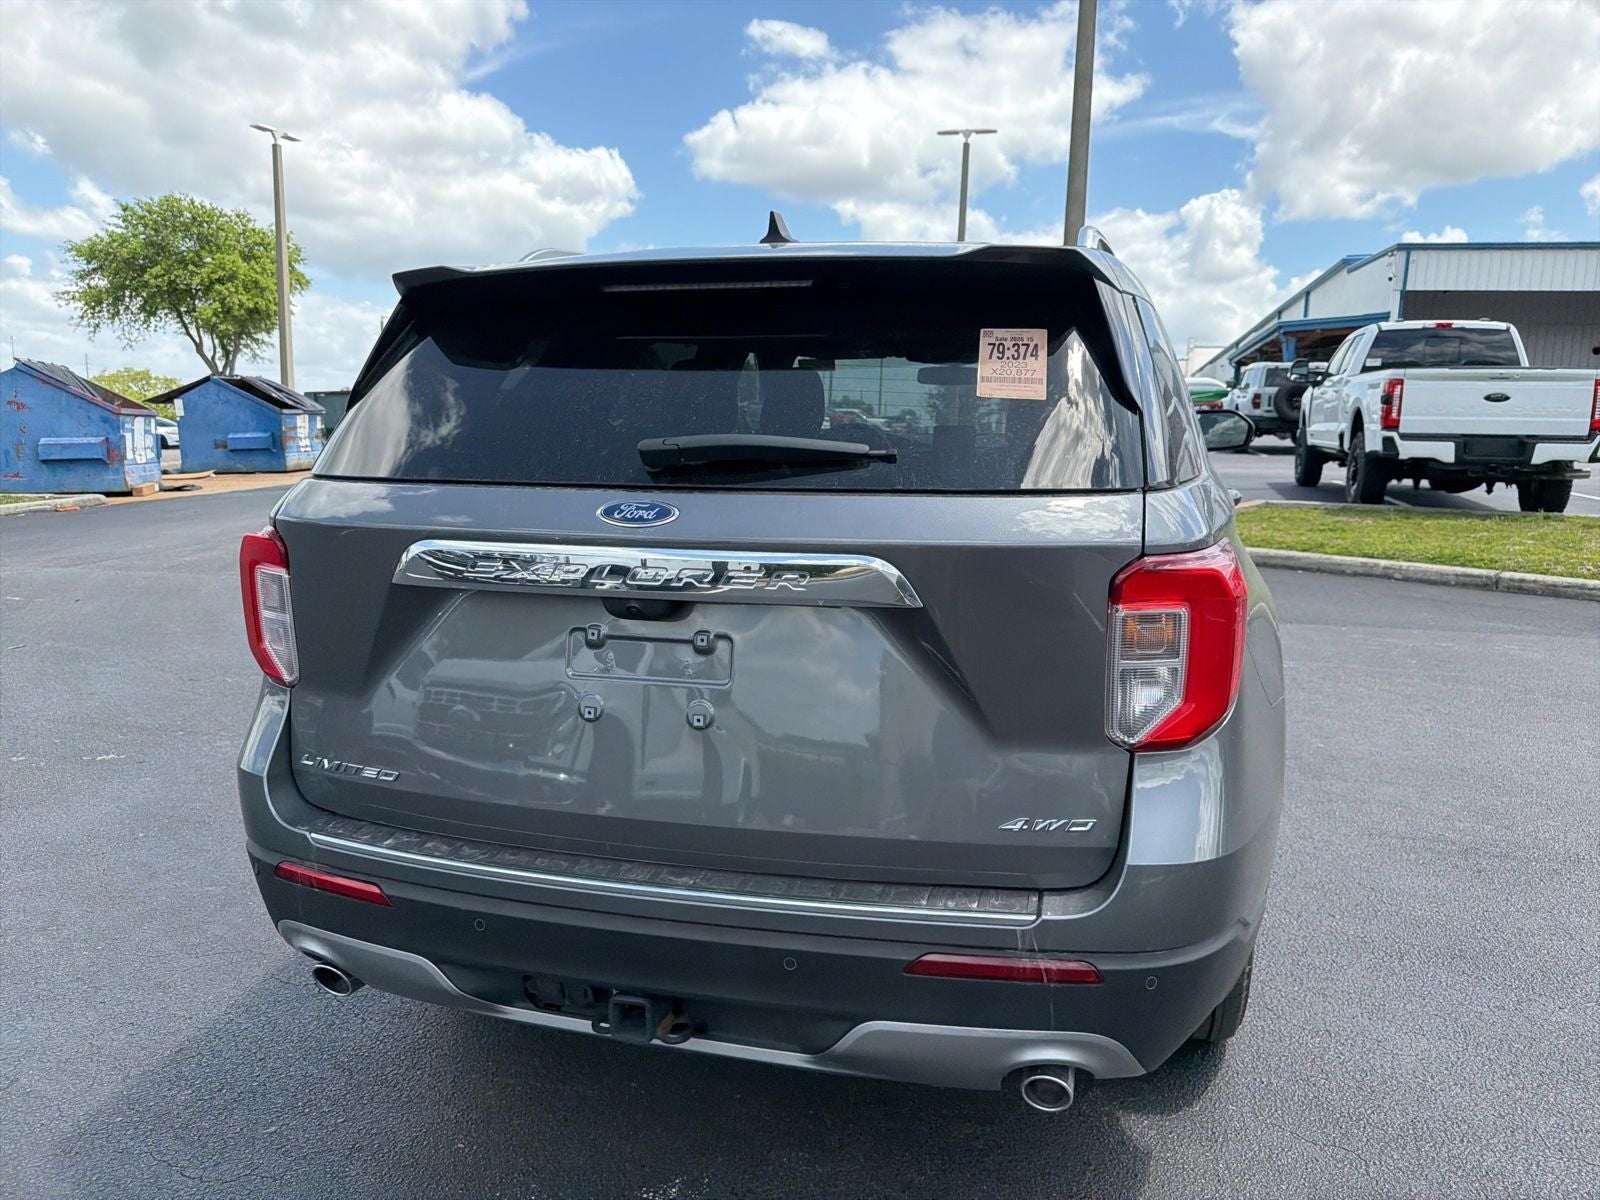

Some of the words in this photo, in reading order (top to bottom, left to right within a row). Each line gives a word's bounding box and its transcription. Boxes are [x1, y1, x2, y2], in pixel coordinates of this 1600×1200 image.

[987, 342, 1040, 361] 79:374
[990, 368, 1037, 377] X20,877
[1000, 361, 1028, 369] 2023
[614, 502, 660, 519] Ford
[463, 559, 812, 591] EXPLORER
[300, 754, 400, 781] LIMITED
[999, 817, 1097, 832] 4WD
